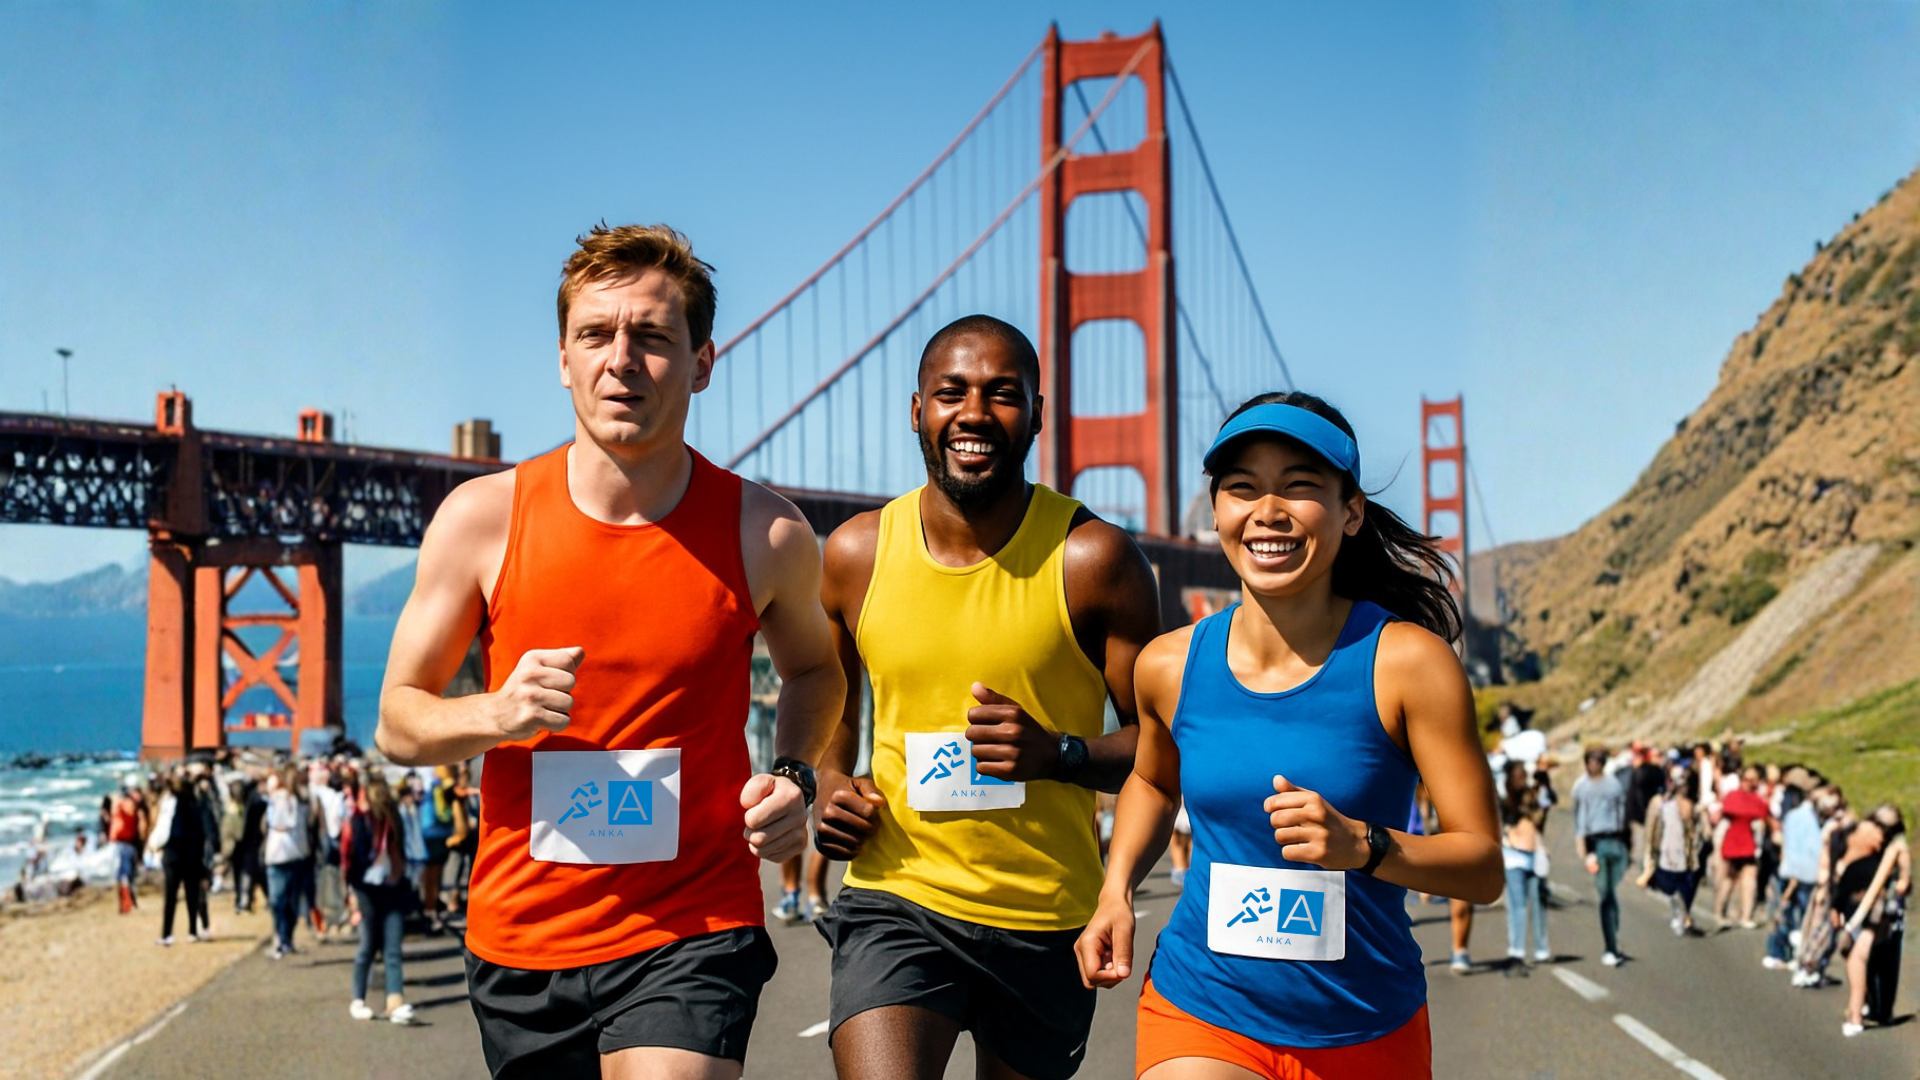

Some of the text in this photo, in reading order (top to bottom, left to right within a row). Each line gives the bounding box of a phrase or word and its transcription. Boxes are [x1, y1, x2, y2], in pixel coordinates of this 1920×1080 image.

[612, 785, 649, 821] A
[588, 829, 624, 837] ANKA
[1281, 894, 1318, 932] A
[1256, 935, 1292, 946] ANKA
